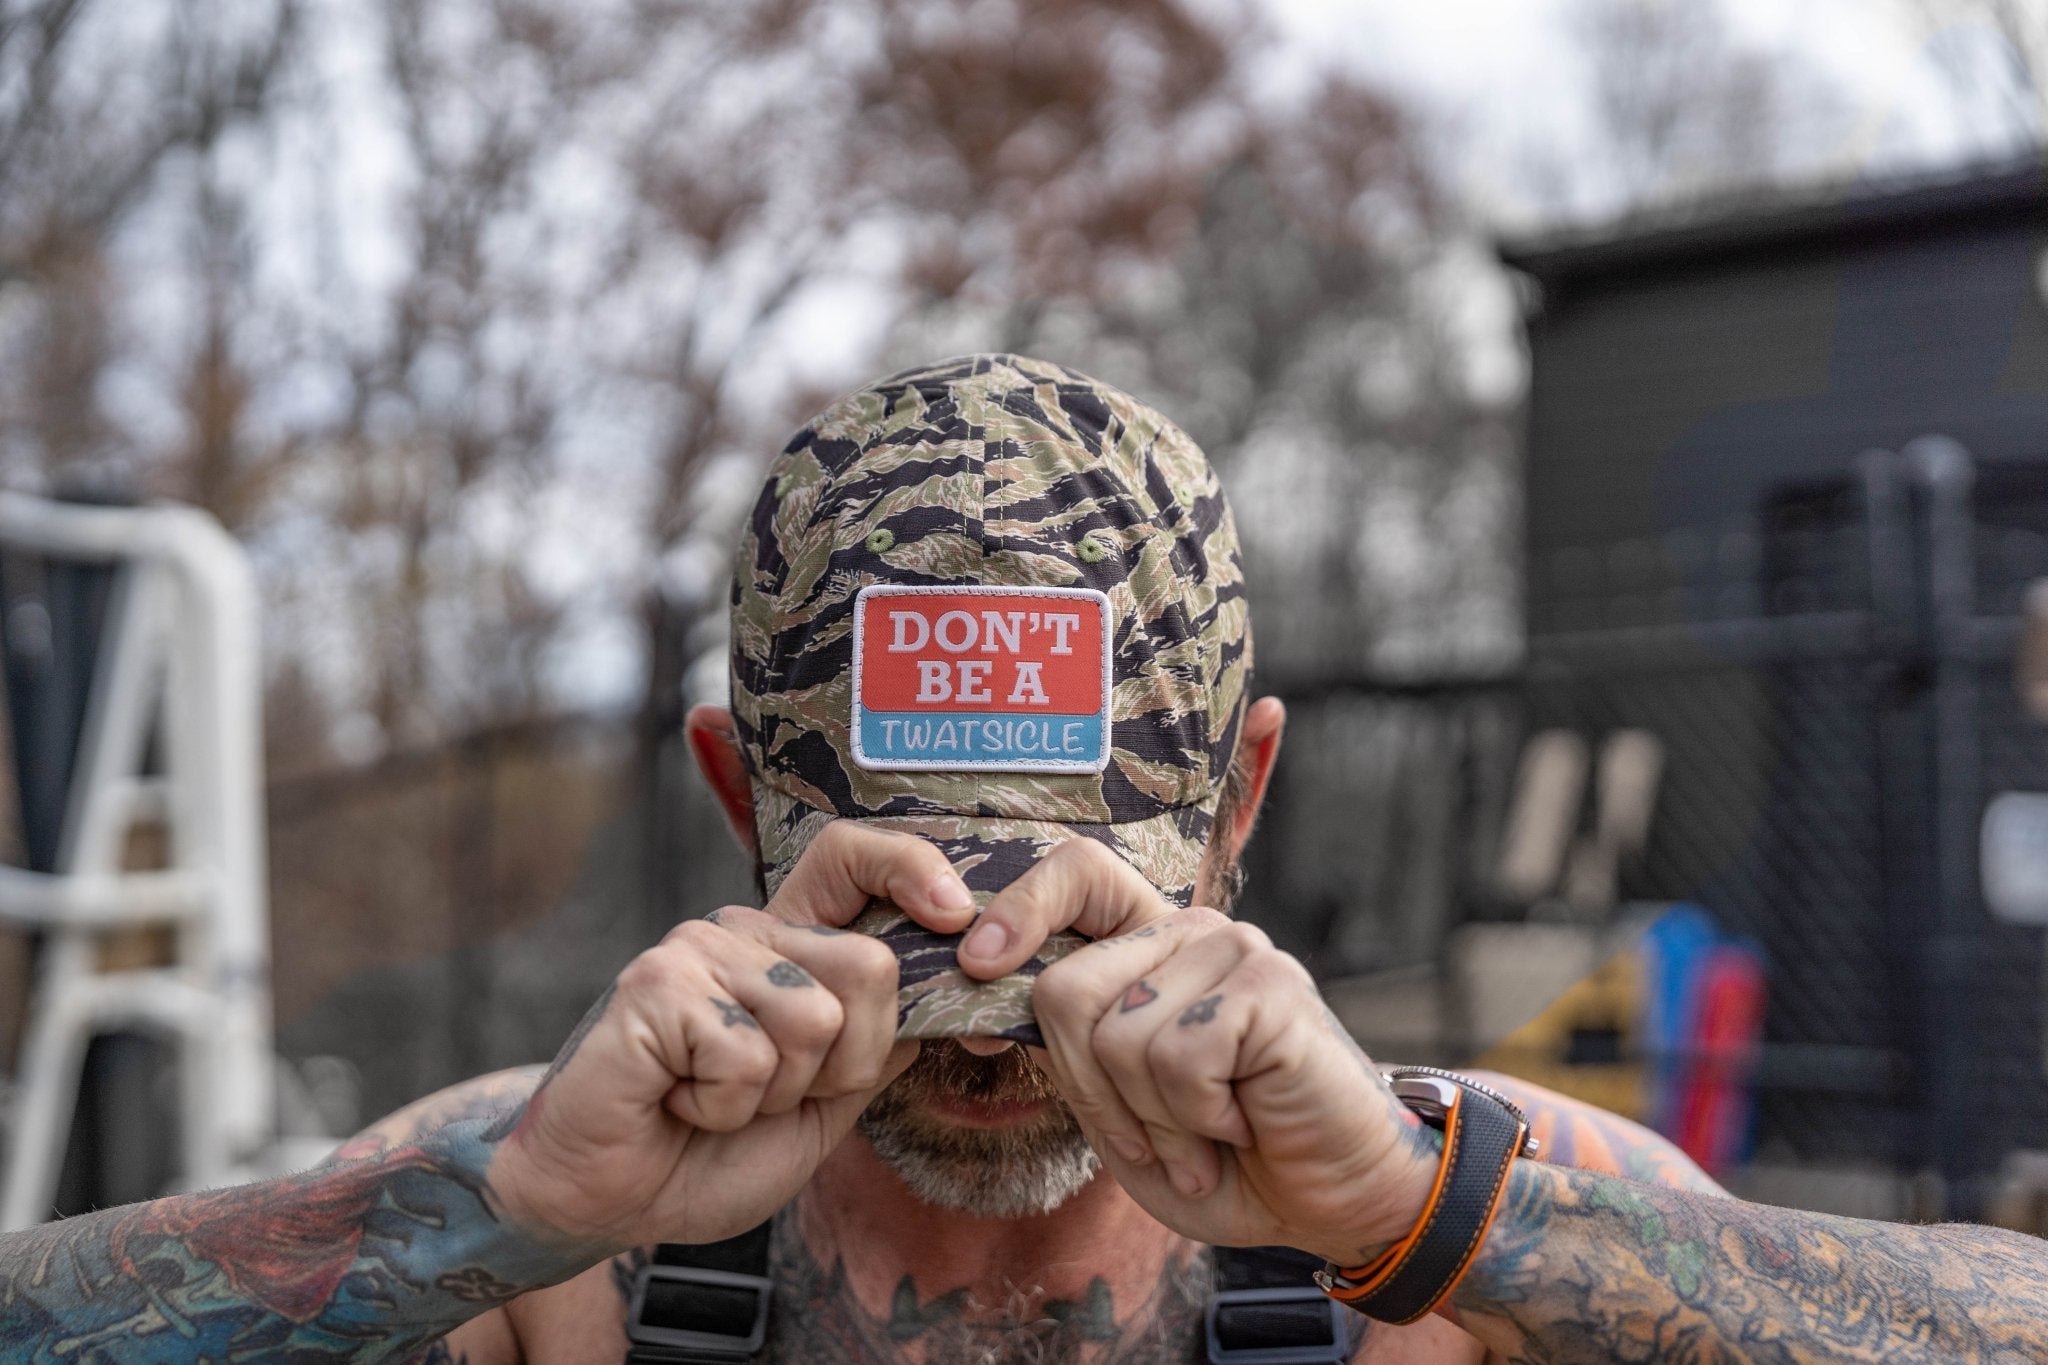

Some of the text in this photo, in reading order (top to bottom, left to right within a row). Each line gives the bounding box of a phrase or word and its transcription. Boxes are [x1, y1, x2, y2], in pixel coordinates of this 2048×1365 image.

[888, 610, 1080, 655] DON'T
[916, 660, 1050, 706] BE A
[880, 719, 1085, 754] TWATSICLE
